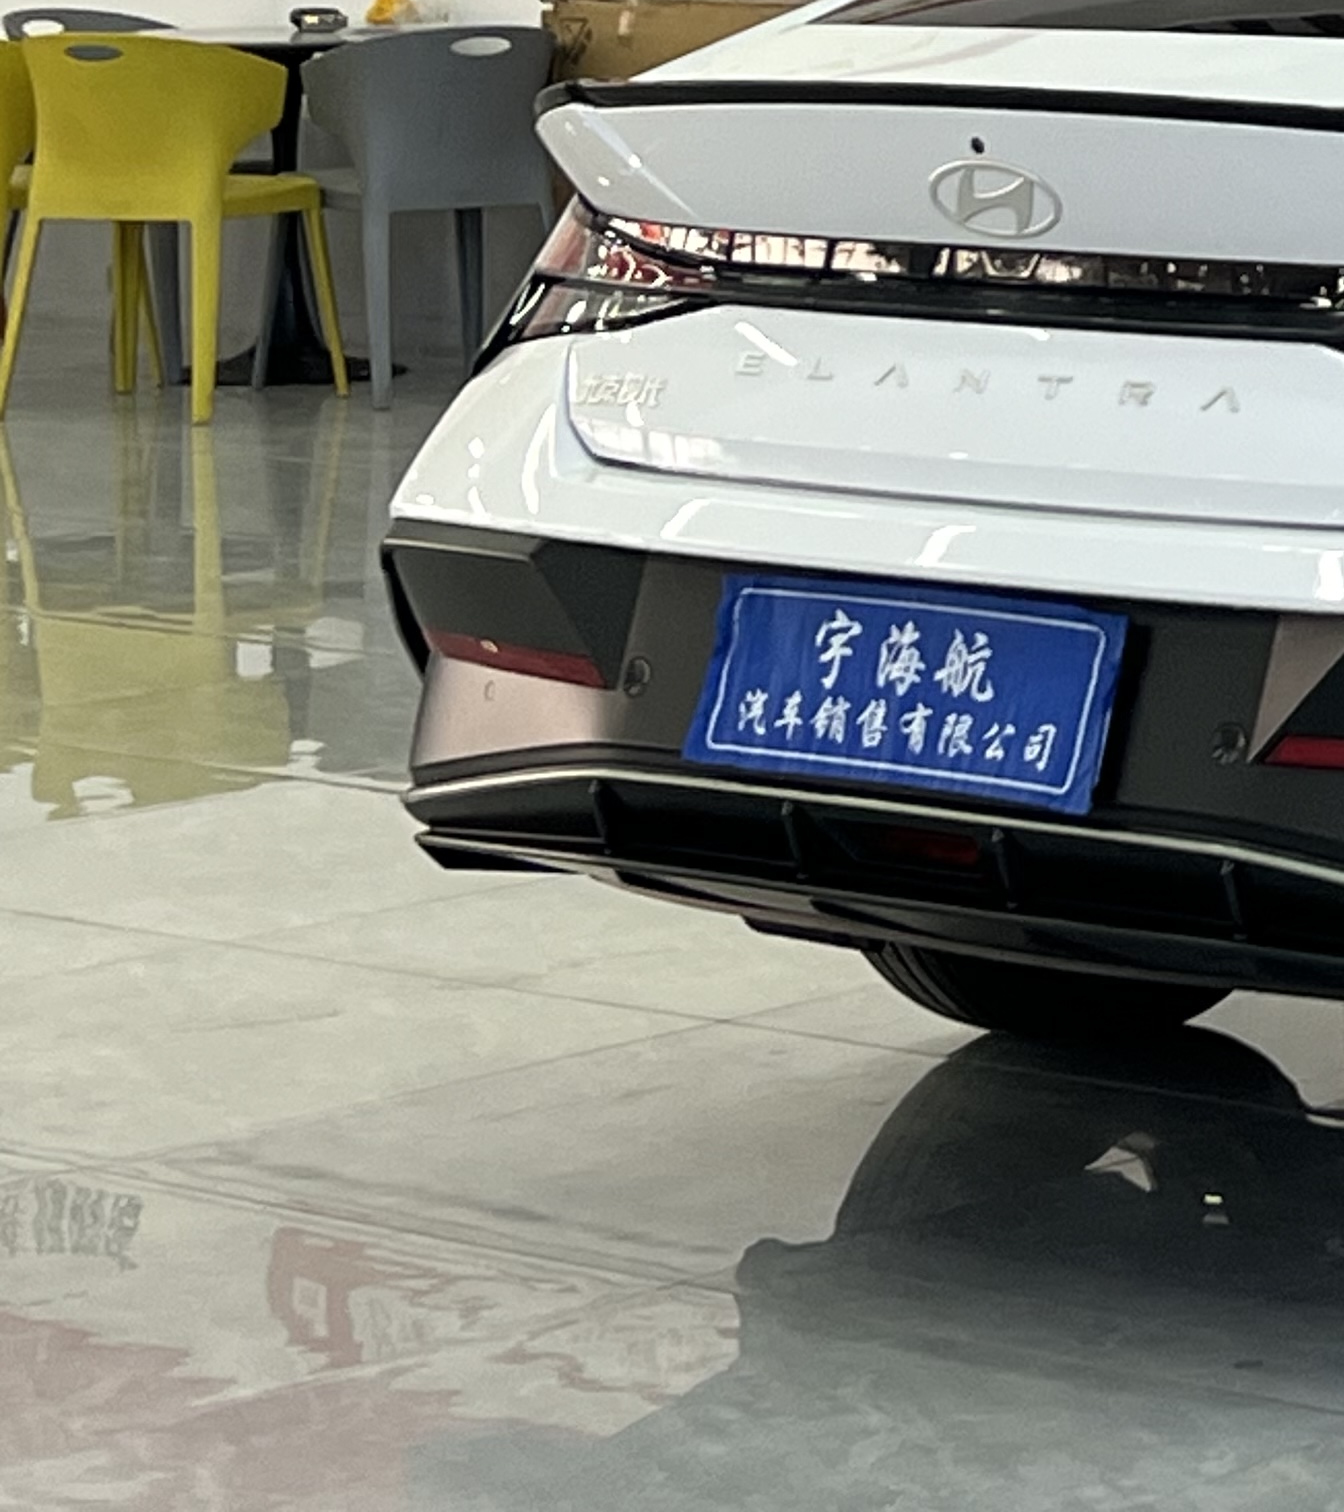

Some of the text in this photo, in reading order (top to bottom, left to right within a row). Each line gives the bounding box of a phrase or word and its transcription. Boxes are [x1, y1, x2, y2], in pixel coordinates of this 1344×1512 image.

[733, 351, 1241, 414] ELANTRA
[814, 608, 994, 702] 宇海航
[737, 687, 1058, 772] 汽车销售有限公司
